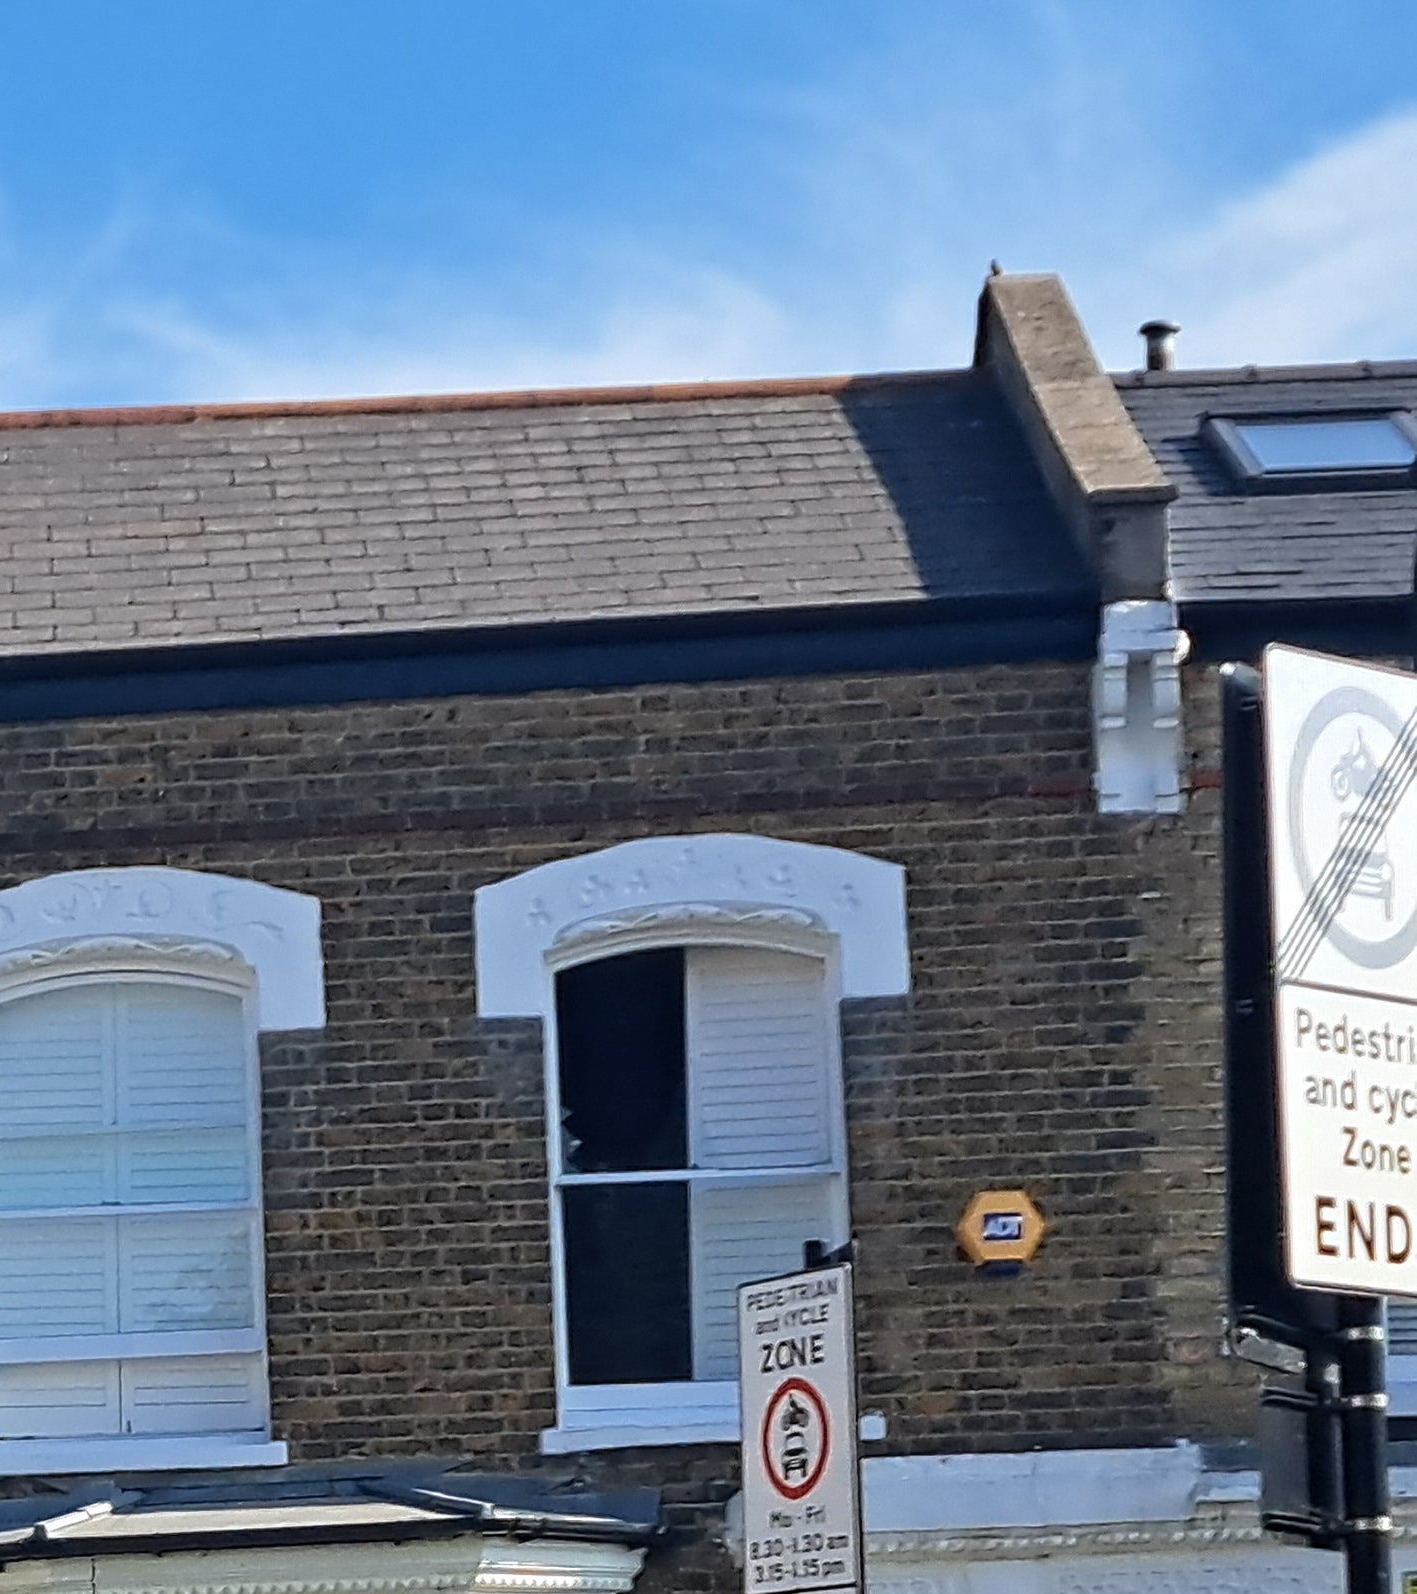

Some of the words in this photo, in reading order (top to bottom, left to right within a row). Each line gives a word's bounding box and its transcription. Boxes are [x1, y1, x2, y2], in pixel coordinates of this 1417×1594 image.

[1304, 1068, 1358, 1111] and
[1367, 1083, 1417, 1126] cyc
[1341, 1126, 1411, 1175] Zone
[1314, 1194, 1412, 1264] END
[760, 1333, 825, 1373] ZONE
